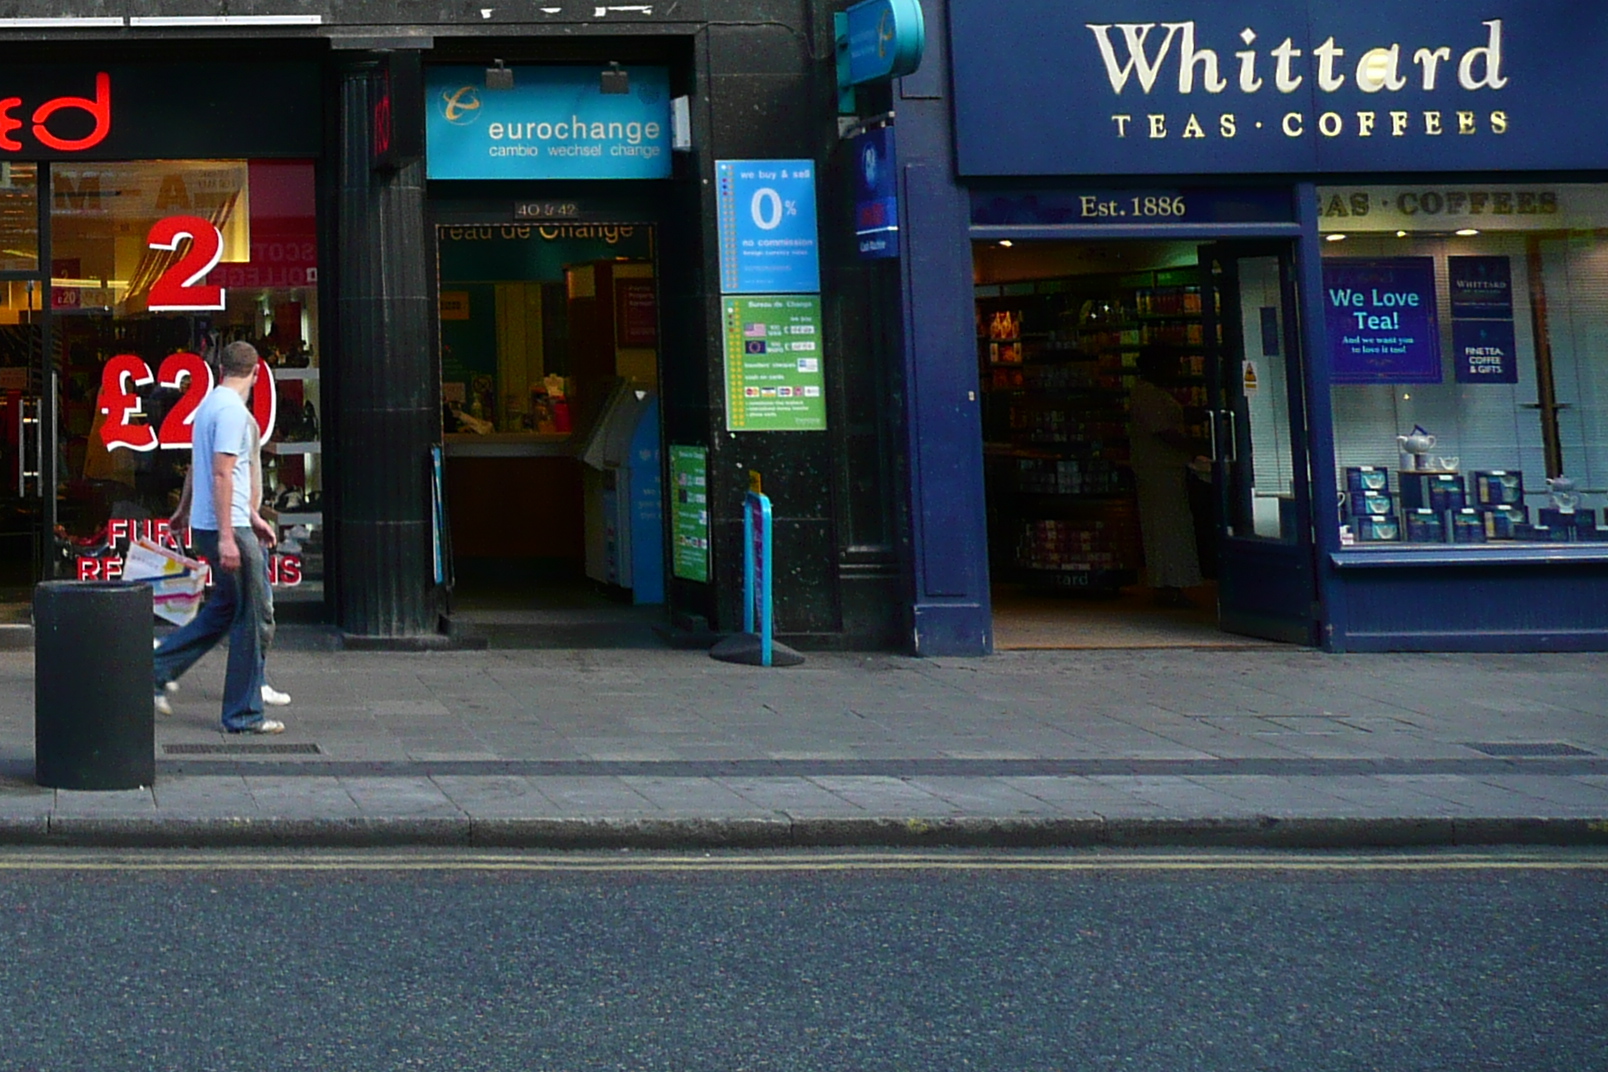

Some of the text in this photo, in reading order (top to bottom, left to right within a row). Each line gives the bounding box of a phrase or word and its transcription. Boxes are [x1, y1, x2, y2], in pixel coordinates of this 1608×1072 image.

[1084, 19, 1509, 94] Whittard
[488, 115, 660, 144] eurochange
[1111, 111, 1508, 138] TEAS COFFEES
[488, 143, 660, 159] cambio wechsel change
[740, 169, 811, 180] we buy & sell
[518, 204, 540, 216] 40
[557, 204, 577, 215] 42
[1079, 196, 1186, 217] Est. 1886
[1396, 191, 1558, 216] COFFEES
[539, 226, 634, 244] Change
[742, 239, 814, 247] no commission
[146, 214, 226, 312] 2
[1456, 280, 1507, 288] WHITTARD
[1328, 288, 1420, 307] We Love
[1353, 312, 1399, 330] Tea!
[1342, 336, 1360, 344] And
[1376, 336, 1396, 344] want
[1398, 337, 1414, 346] you
[1362, 345, 1379, 353] love
[1465, 347, 1485, 356] FINE
[1469, 356, 1501, 364] COFFEE
